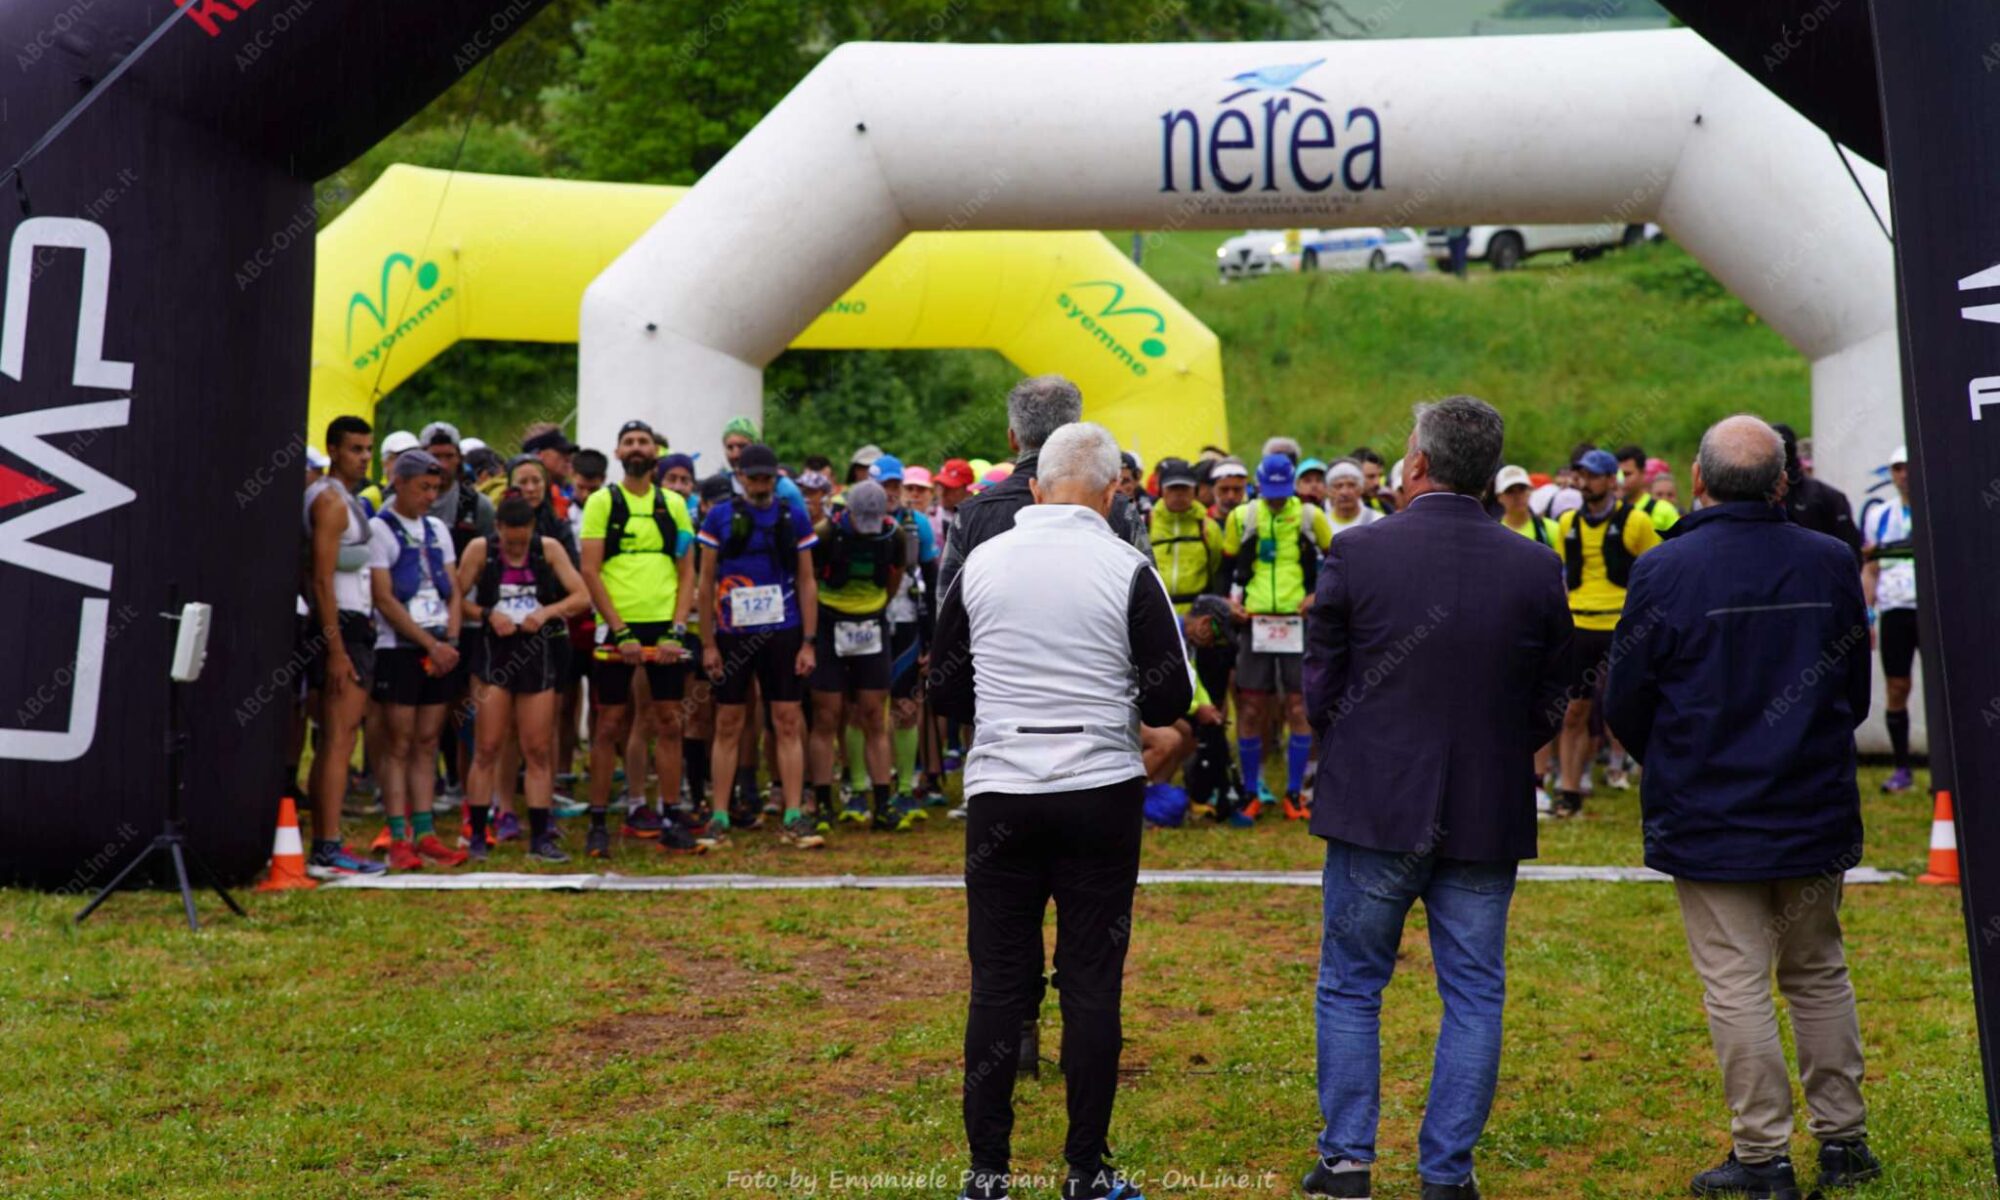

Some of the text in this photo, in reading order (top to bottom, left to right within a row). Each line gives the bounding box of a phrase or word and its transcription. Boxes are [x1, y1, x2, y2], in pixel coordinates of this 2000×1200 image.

[1160, 96, 1385, 193] nerea
[1057, 292, 1147, 377] syemme
[743, 597, 773, 613] 127
